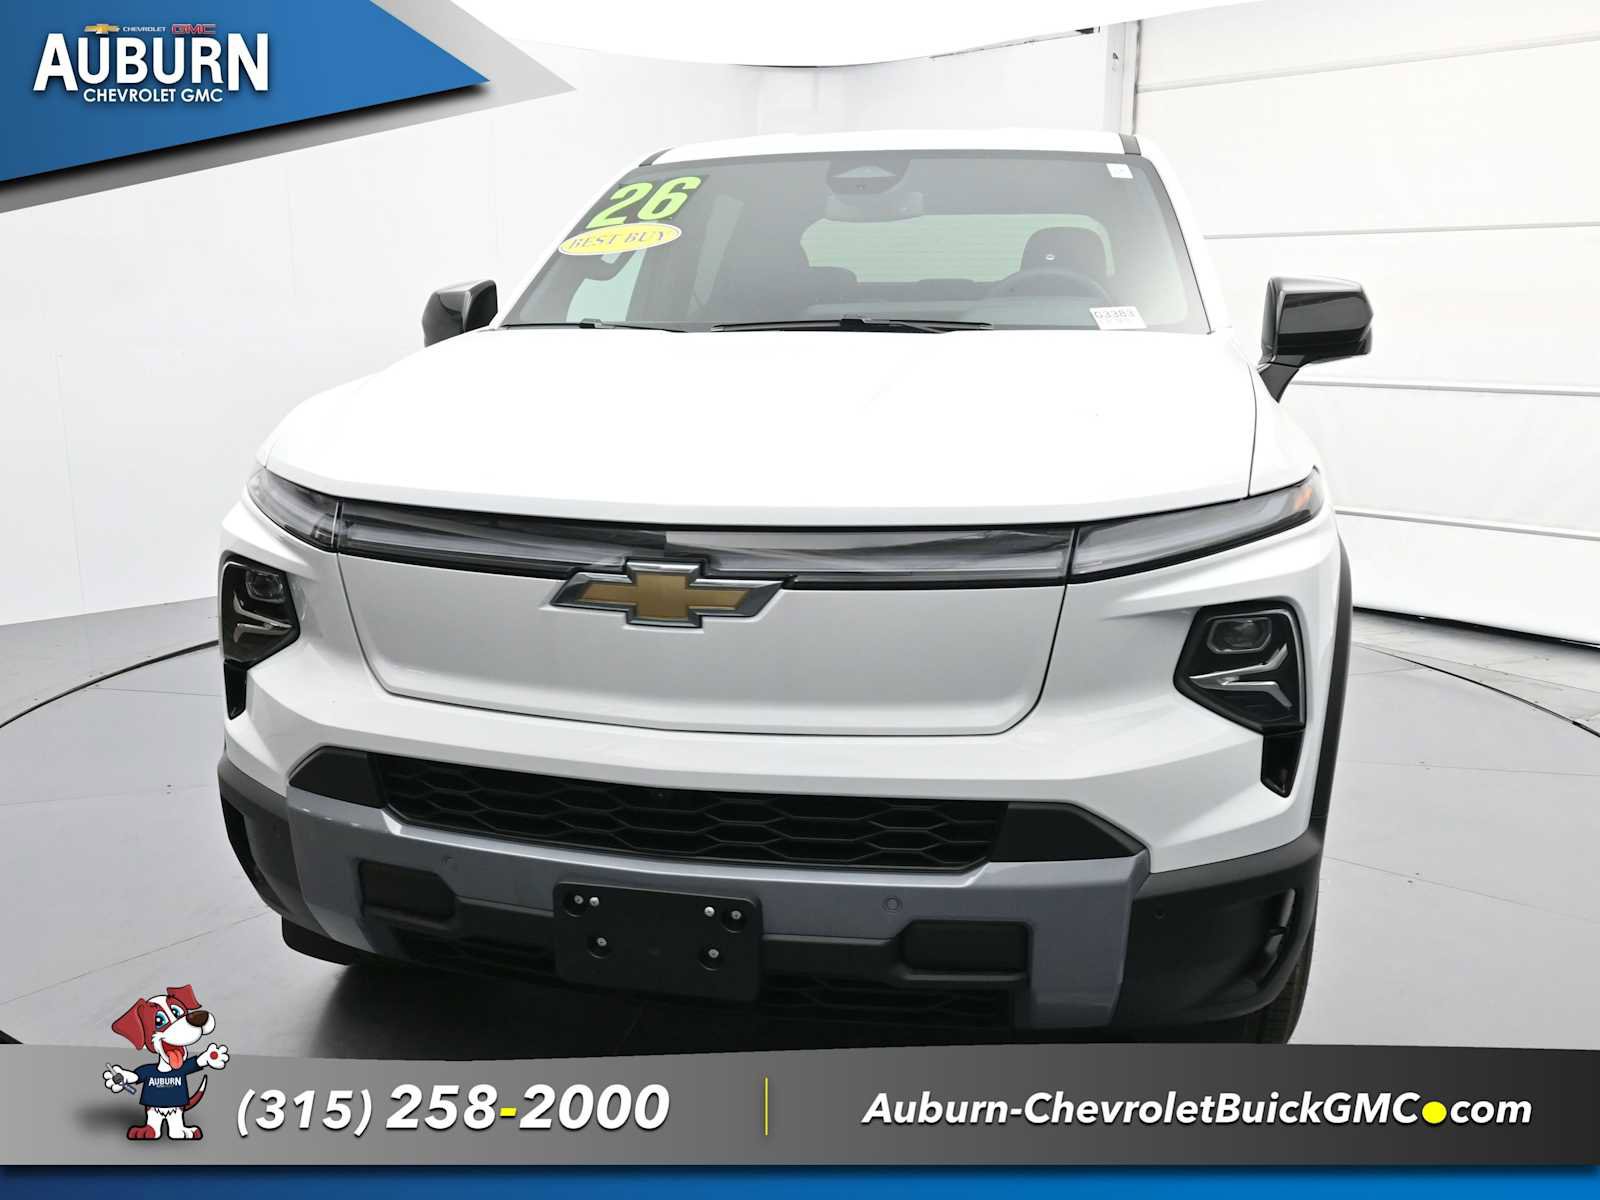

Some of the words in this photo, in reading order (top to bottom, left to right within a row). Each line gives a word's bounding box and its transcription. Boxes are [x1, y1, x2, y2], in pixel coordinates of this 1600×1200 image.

[585, 176, 702, 229] 26
[567, 234, 619, 250] BEST
[624, 230, 668, 244] BUY
